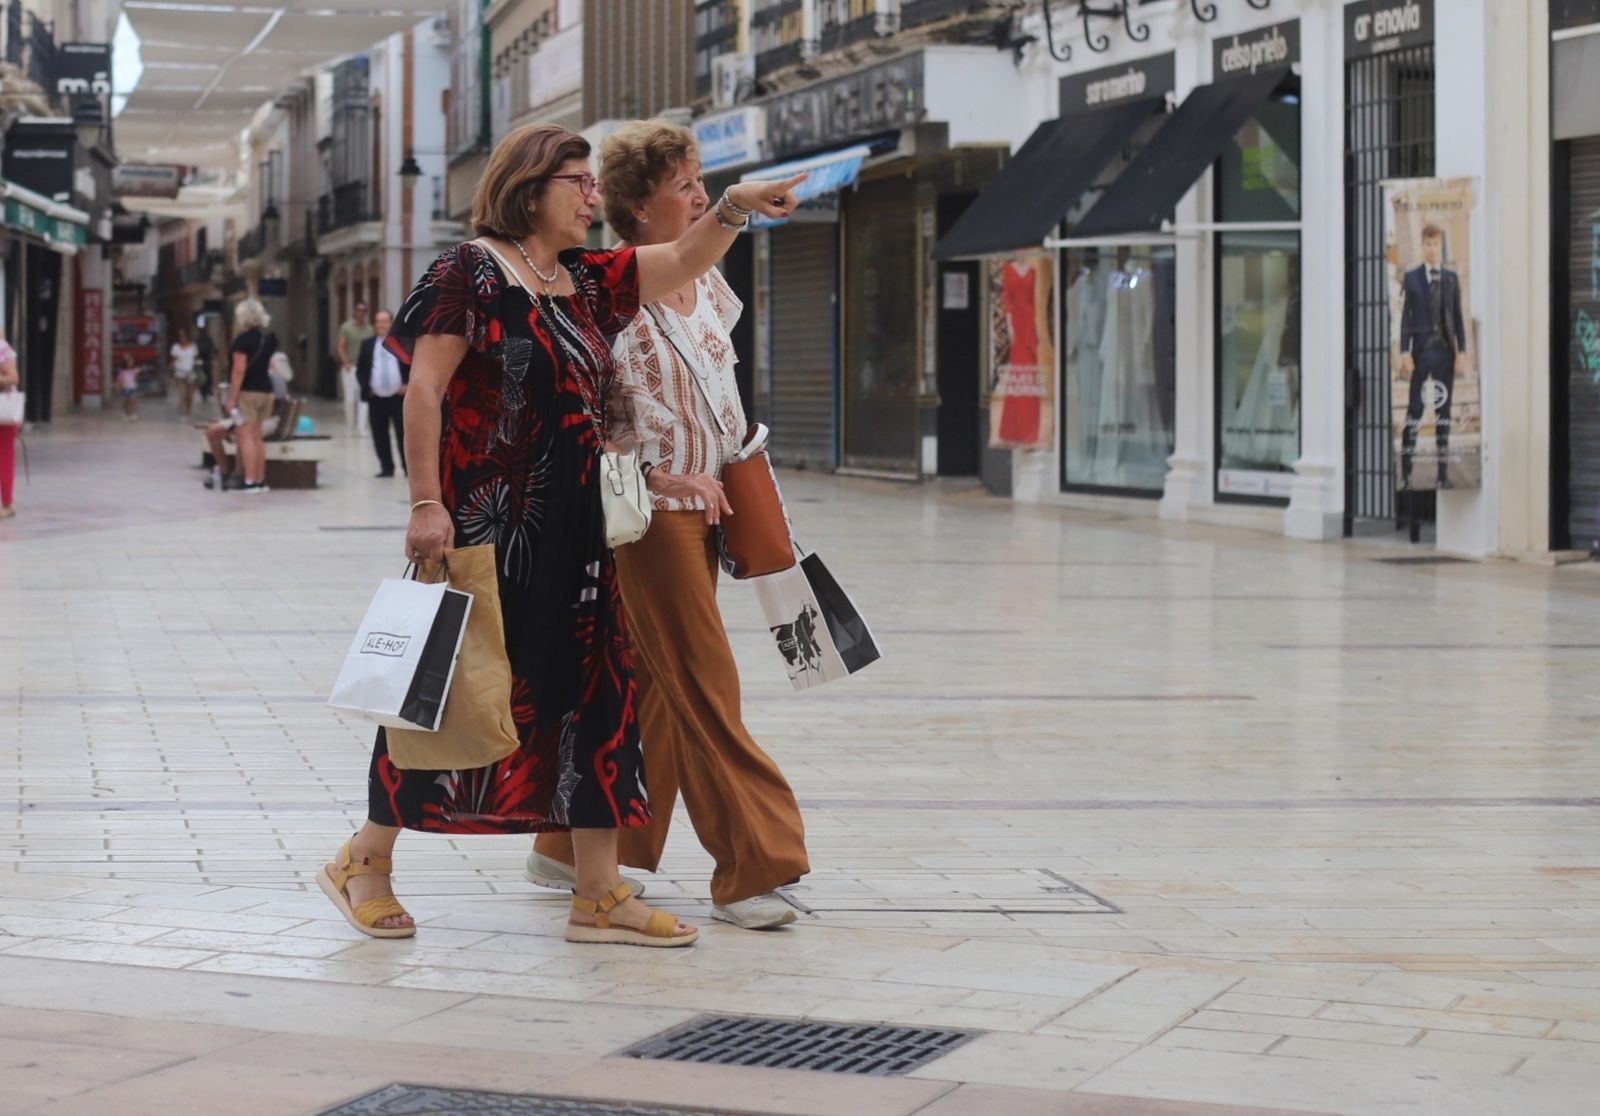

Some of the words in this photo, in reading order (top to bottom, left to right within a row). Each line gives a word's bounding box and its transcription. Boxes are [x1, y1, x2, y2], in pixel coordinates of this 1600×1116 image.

[1374, 0, 1420, 37] enovia
[1222, 35, 1250, 72] celso
[1251, 26, 1287, 75] prieto
[366, 637, 405, 652] ALE-HOP
